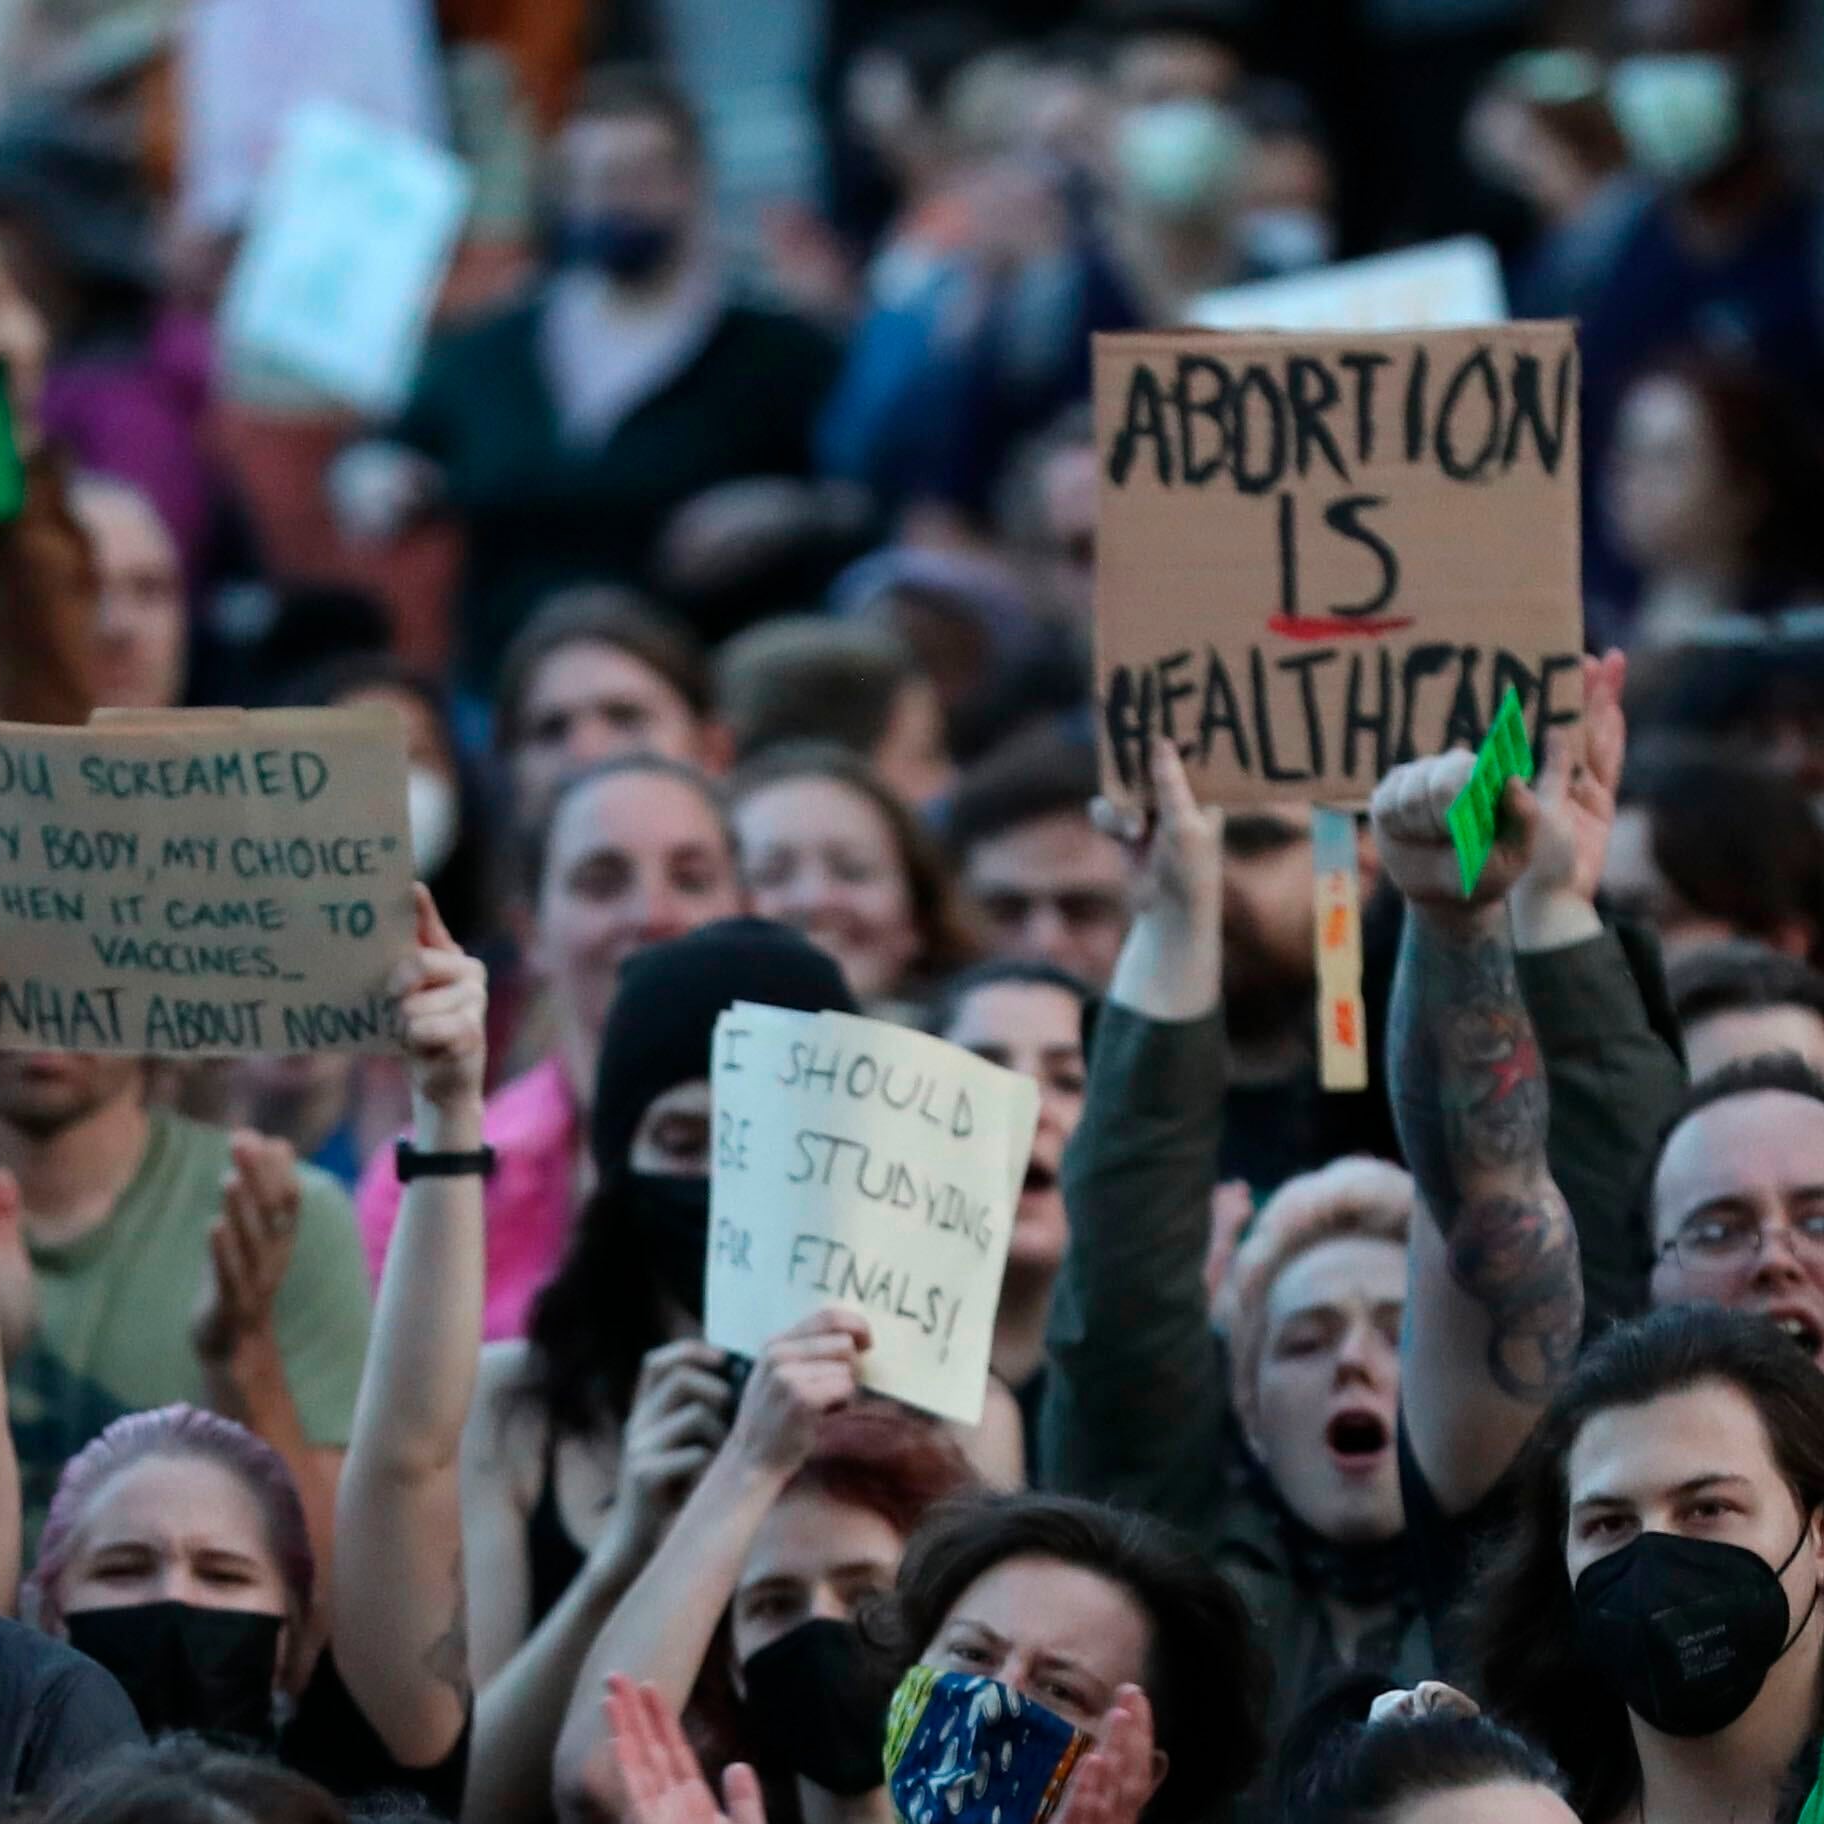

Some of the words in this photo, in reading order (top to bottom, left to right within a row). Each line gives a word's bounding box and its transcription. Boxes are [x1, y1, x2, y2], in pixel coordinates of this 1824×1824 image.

[1108, 345, 1573, 495] ABORTION
[1279, 493, 1401, 618] IS
[81, 749, 330, 804] SCREAMED
[40, 823, 157, 882] BODY,
[161, 837, 219, 864] MY
[229, 836, 399, 880] CHOICE"
[108, 895, 143, 927] IT
[164, 899, 287, 933] CAME
[319, 900, 376, 940] TO
[144, 993, 265, 1050] ABOUT
[720, 1028, 753, 1072] I
[777, 1040, 974, 1140] SHOULD
[786, 1130, 994, 1258] STUDYING
[788, 1233, 962, 1365] FINALS!
